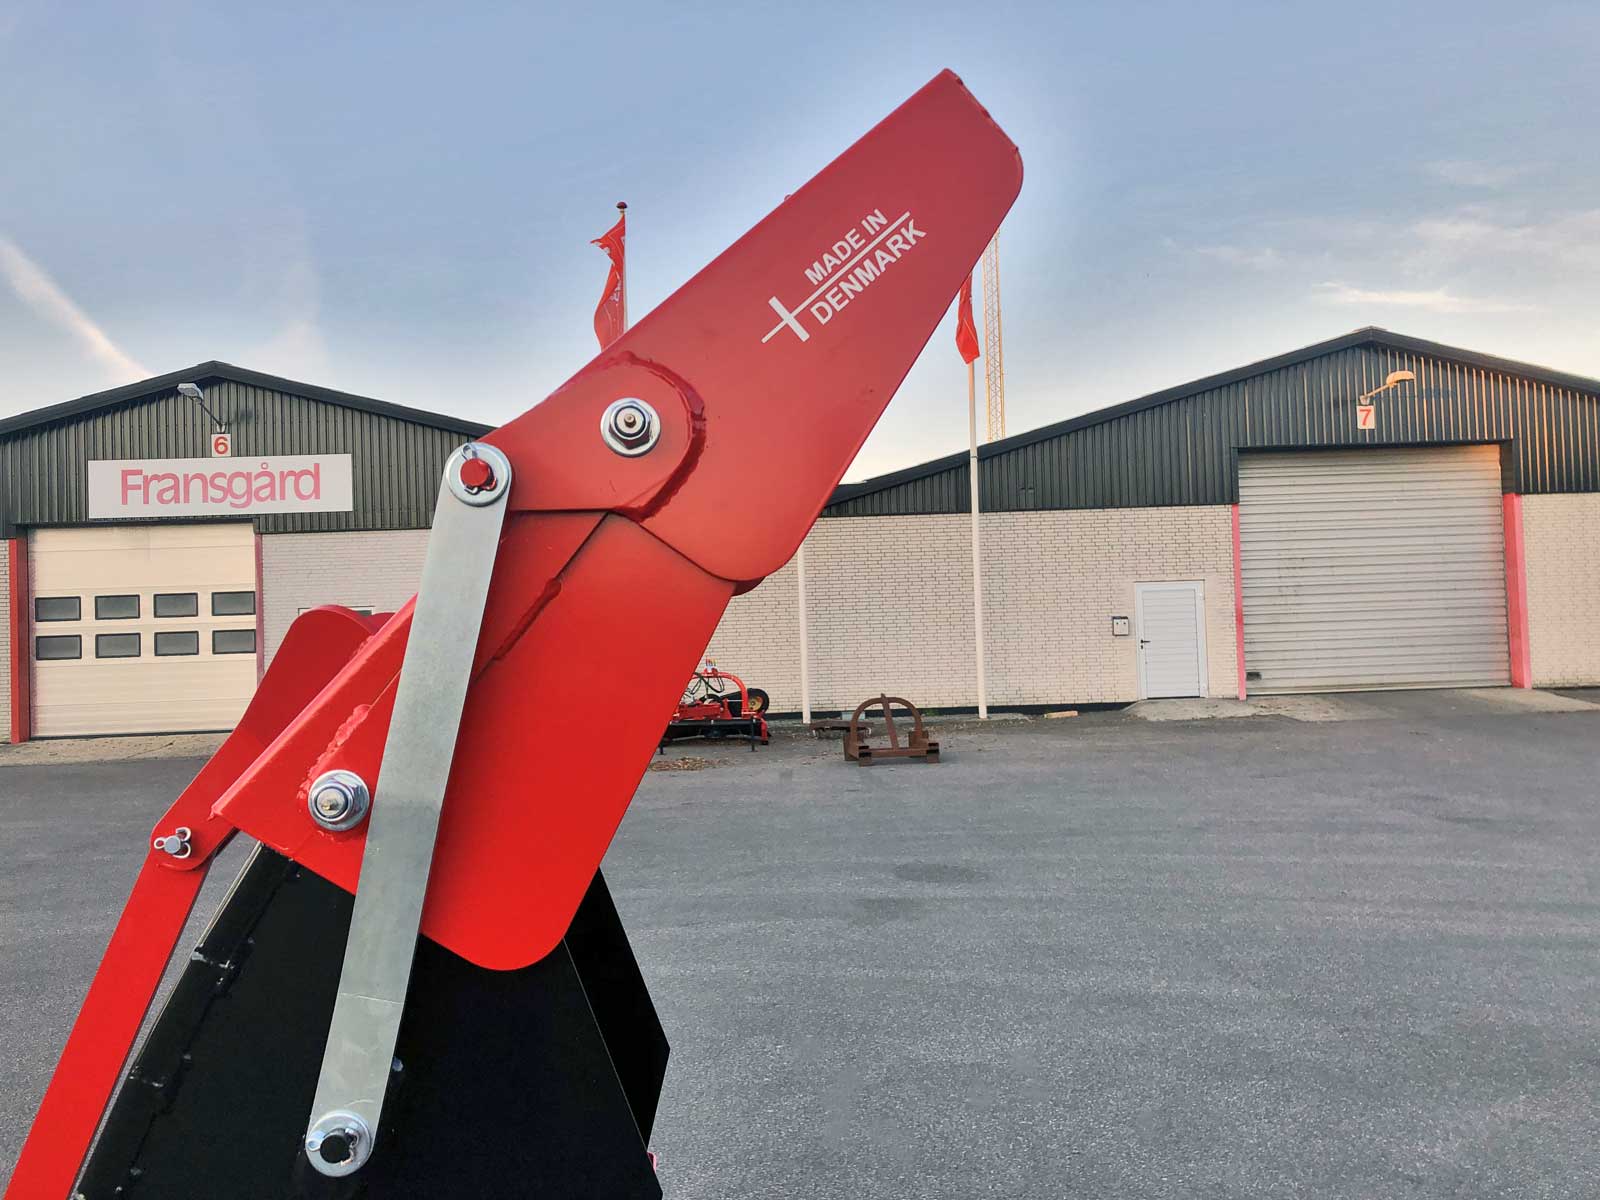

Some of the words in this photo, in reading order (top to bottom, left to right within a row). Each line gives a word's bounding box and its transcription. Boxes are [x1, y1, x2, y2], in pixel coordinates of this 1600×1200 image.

[804, 228, 866, 285] MADE
[861, 208, 889, 236] IN
[810, 219, 927, 325] DENMARK
[1359, 409, 1372, 426] 7
[213, 436, 228, 455] 6
[121, 462, 320, 508] Fransgård
